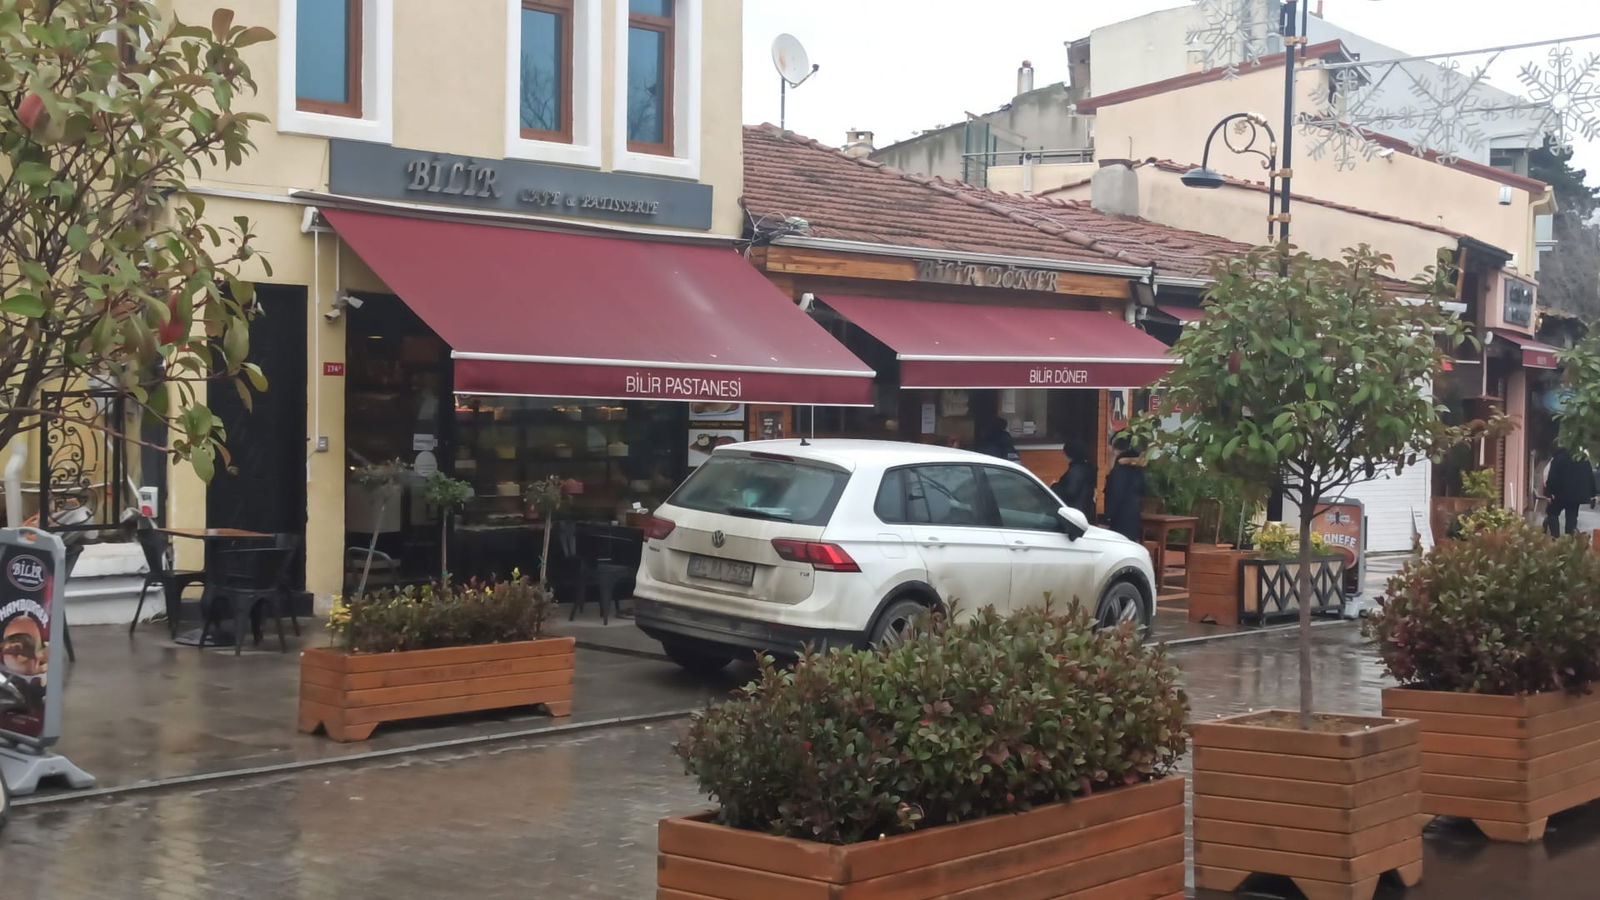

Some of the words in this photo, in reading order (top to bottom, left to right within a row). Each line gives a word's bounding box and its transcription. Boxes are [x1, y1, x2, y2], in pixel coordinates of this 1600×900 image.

[985, 264, 1059, 292] DÖNER
[626, 372, 661, 393] BİLİR
[665, 377, 742, 397] PASTANESİ
[1029, 366, 1052, 384] BİLİR
[1054, 366, 1088, 384] DÖNER
